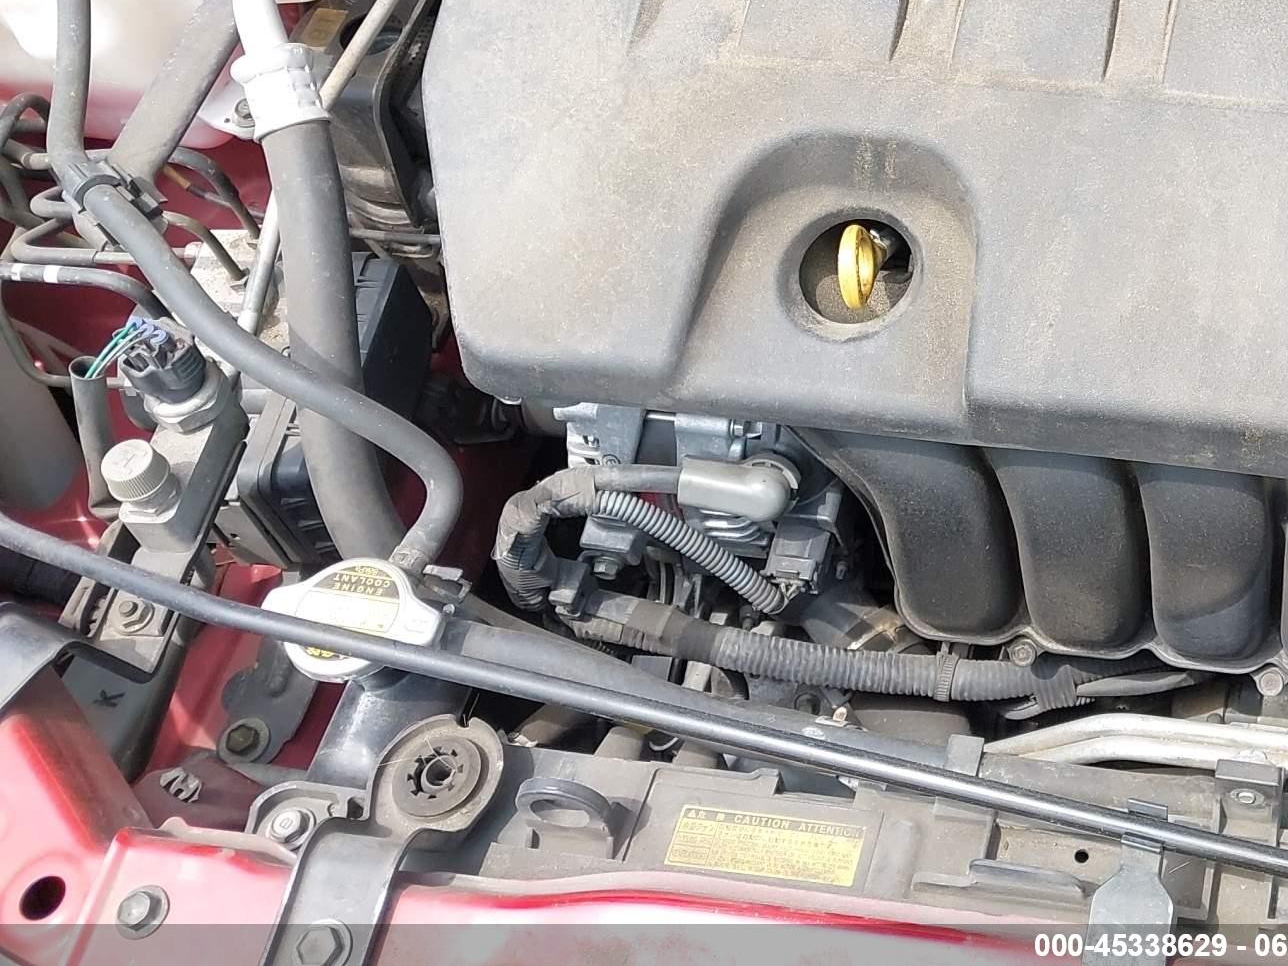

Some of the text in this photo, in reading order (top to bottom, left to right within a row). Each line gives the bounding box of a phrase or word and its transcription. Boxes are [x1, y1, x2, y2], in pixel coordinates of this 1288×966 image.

[333, 573, 390, 588] COOLANT
[332, 582, 384, 596] ENGINE
[734, 813, 790, 830] CAUTION
